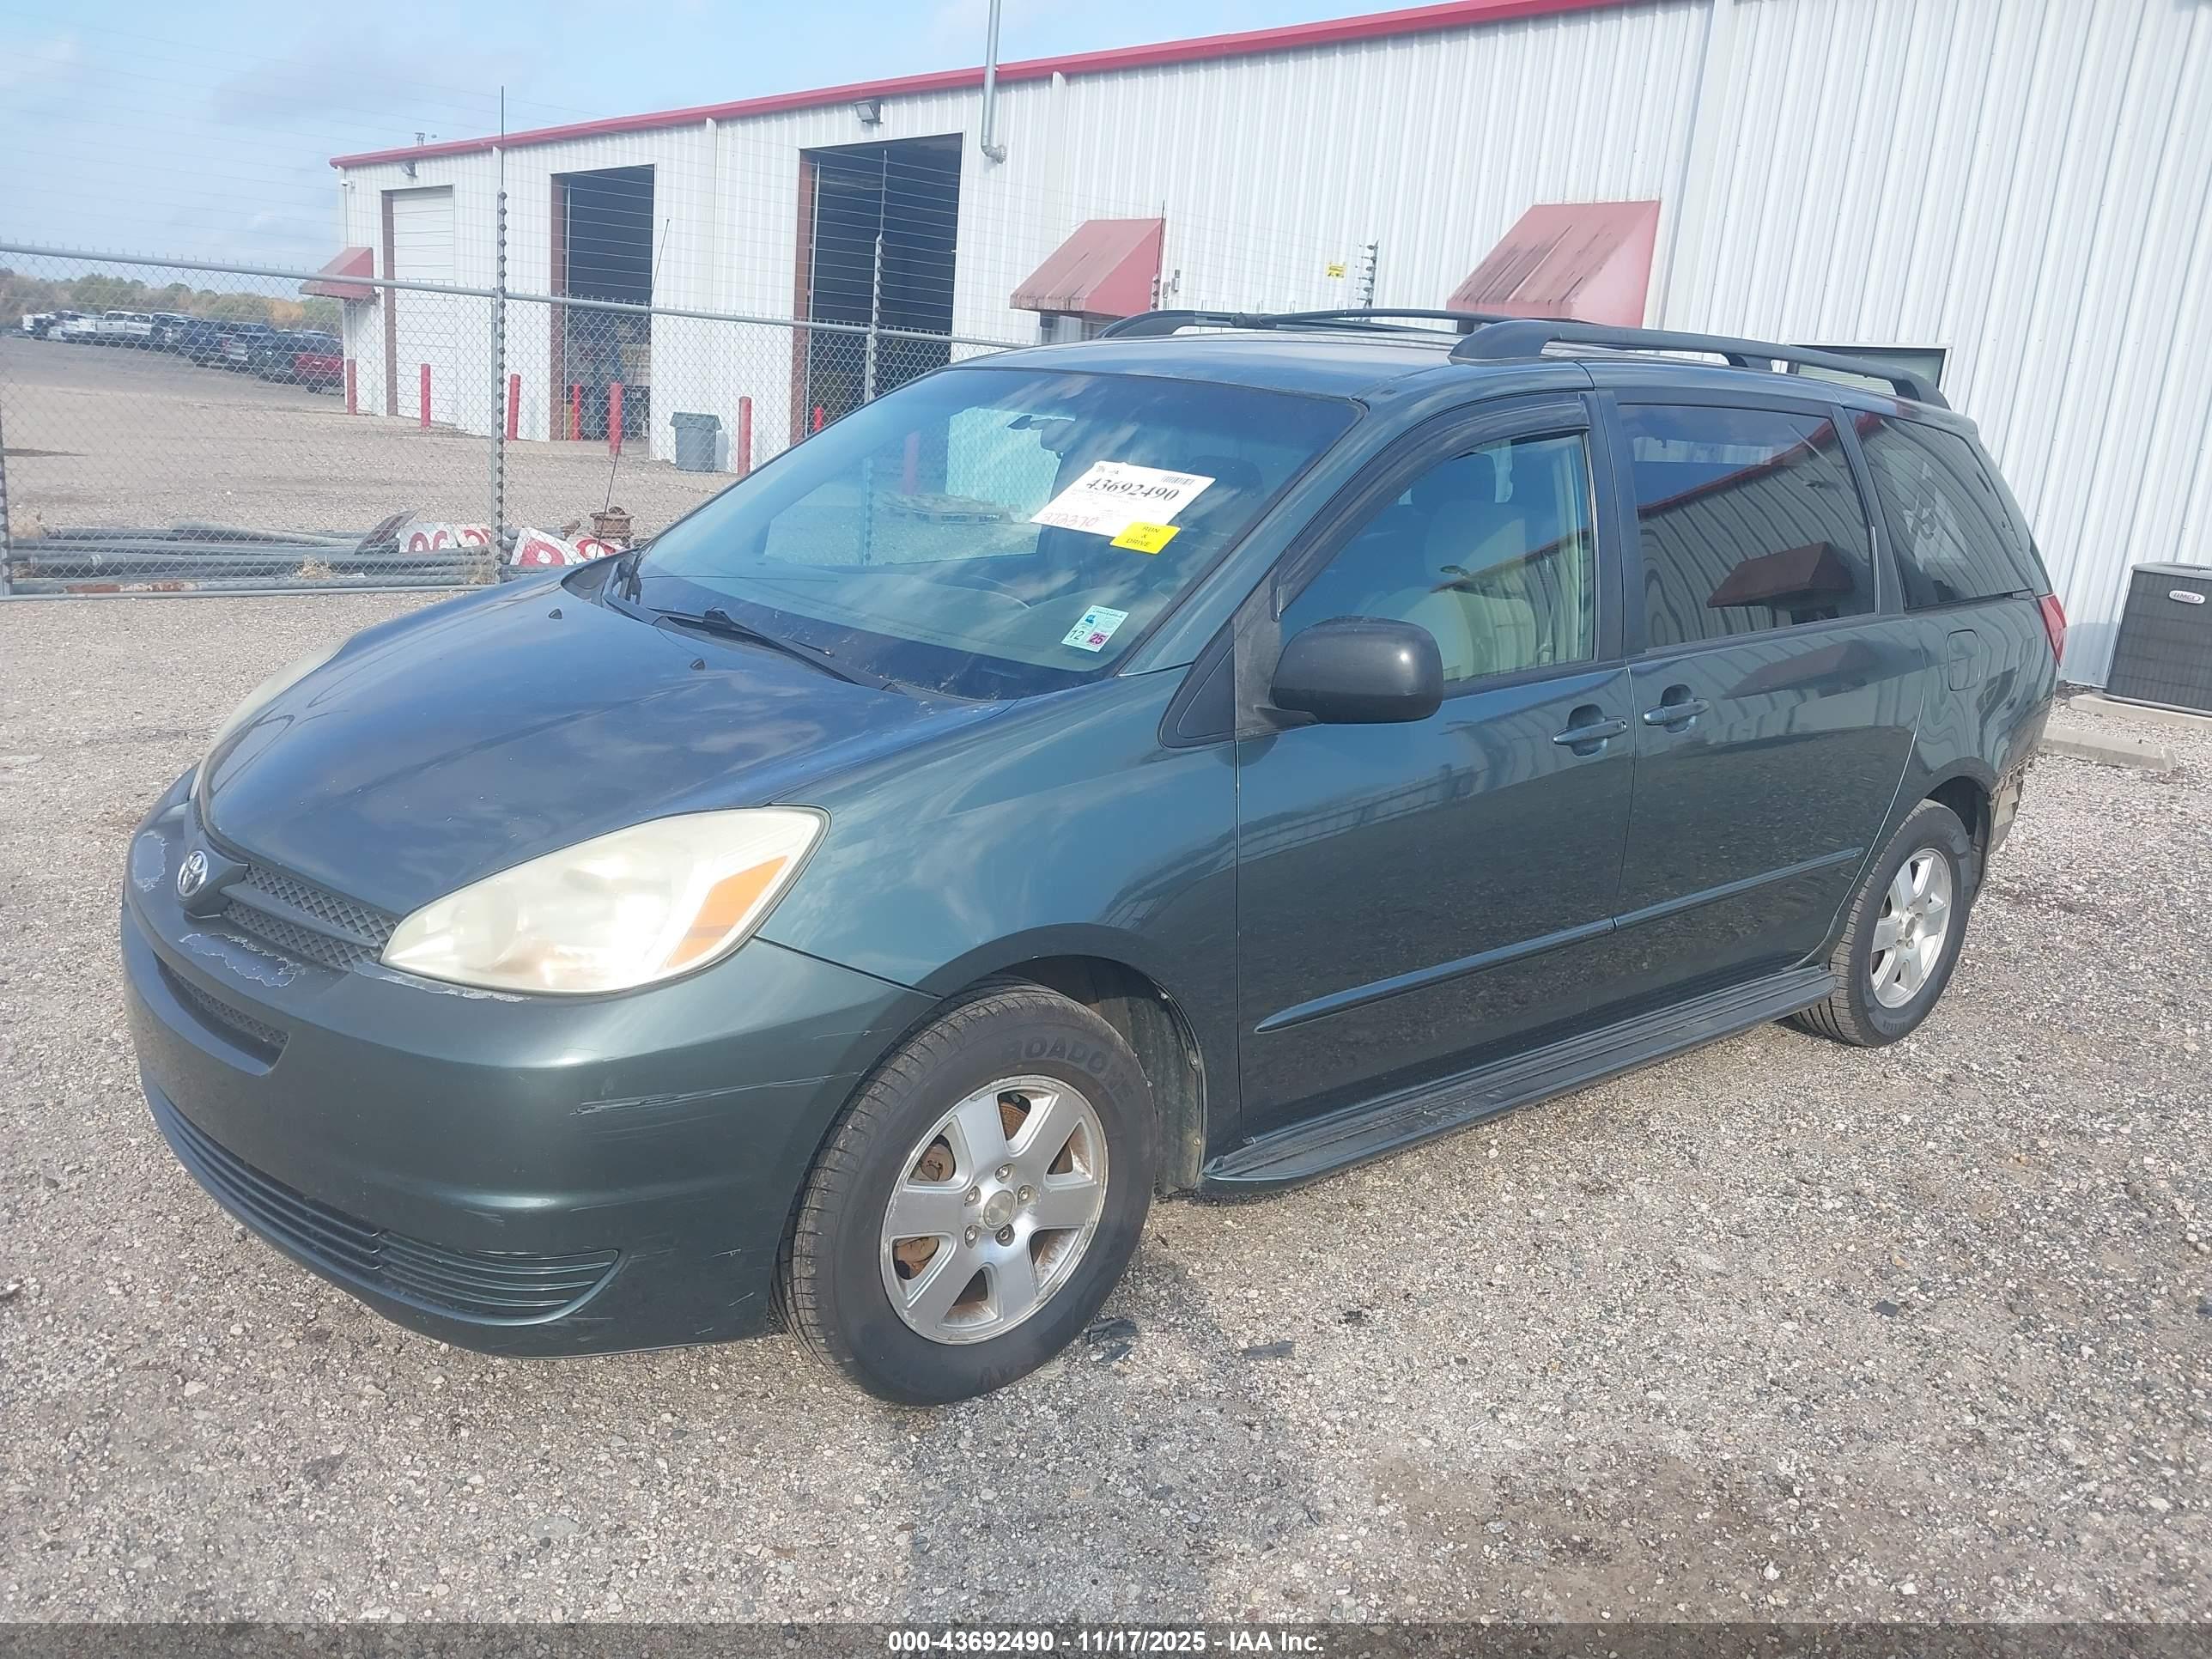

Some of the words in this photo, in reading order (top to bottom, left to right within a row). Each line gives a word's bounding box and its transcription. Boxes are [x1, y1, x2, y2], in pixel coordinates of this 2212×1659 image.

[1086, 478, 1180, 501] 43692490
[1126, 537, 1152, 547] DRIVE
[1070, 629, 1085, 641] 12
[1088, 633, 1107, 645] 25
